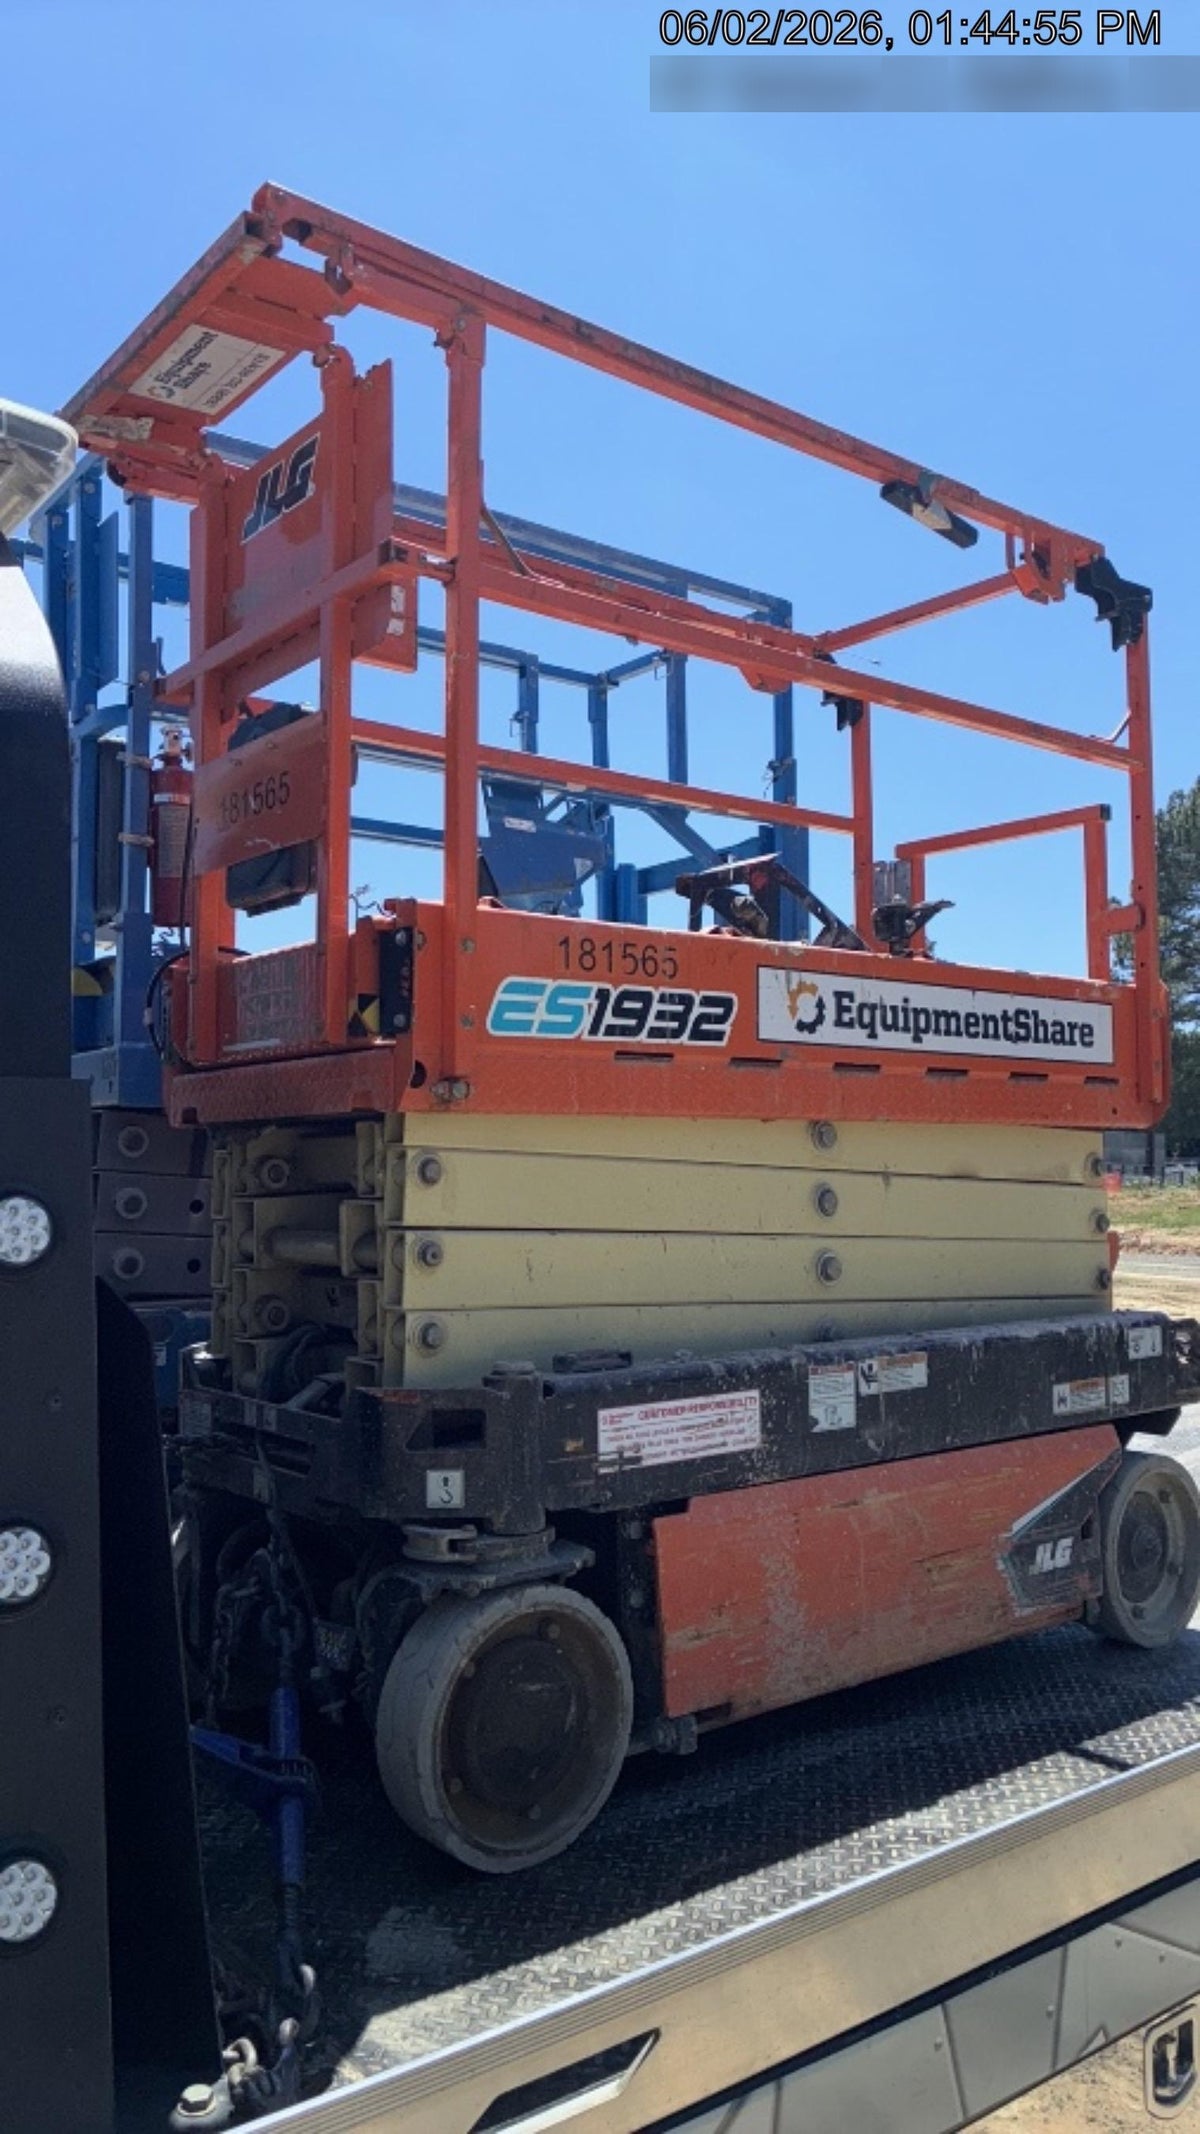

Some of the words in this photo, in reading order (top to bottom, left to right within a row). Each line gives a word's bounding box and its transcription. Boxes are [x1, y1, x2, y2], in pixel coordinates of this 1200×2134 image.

[240, 432, 321, 545] JLG
[220, 771, 290, 824] 181565
[559, 936, 679, 980] 181565
[486, 975, 738, 1046] ES1932
[833, 990, 1095, 1047] EquipmentShare
[1028, 1536, 1075, 1576] JLG
